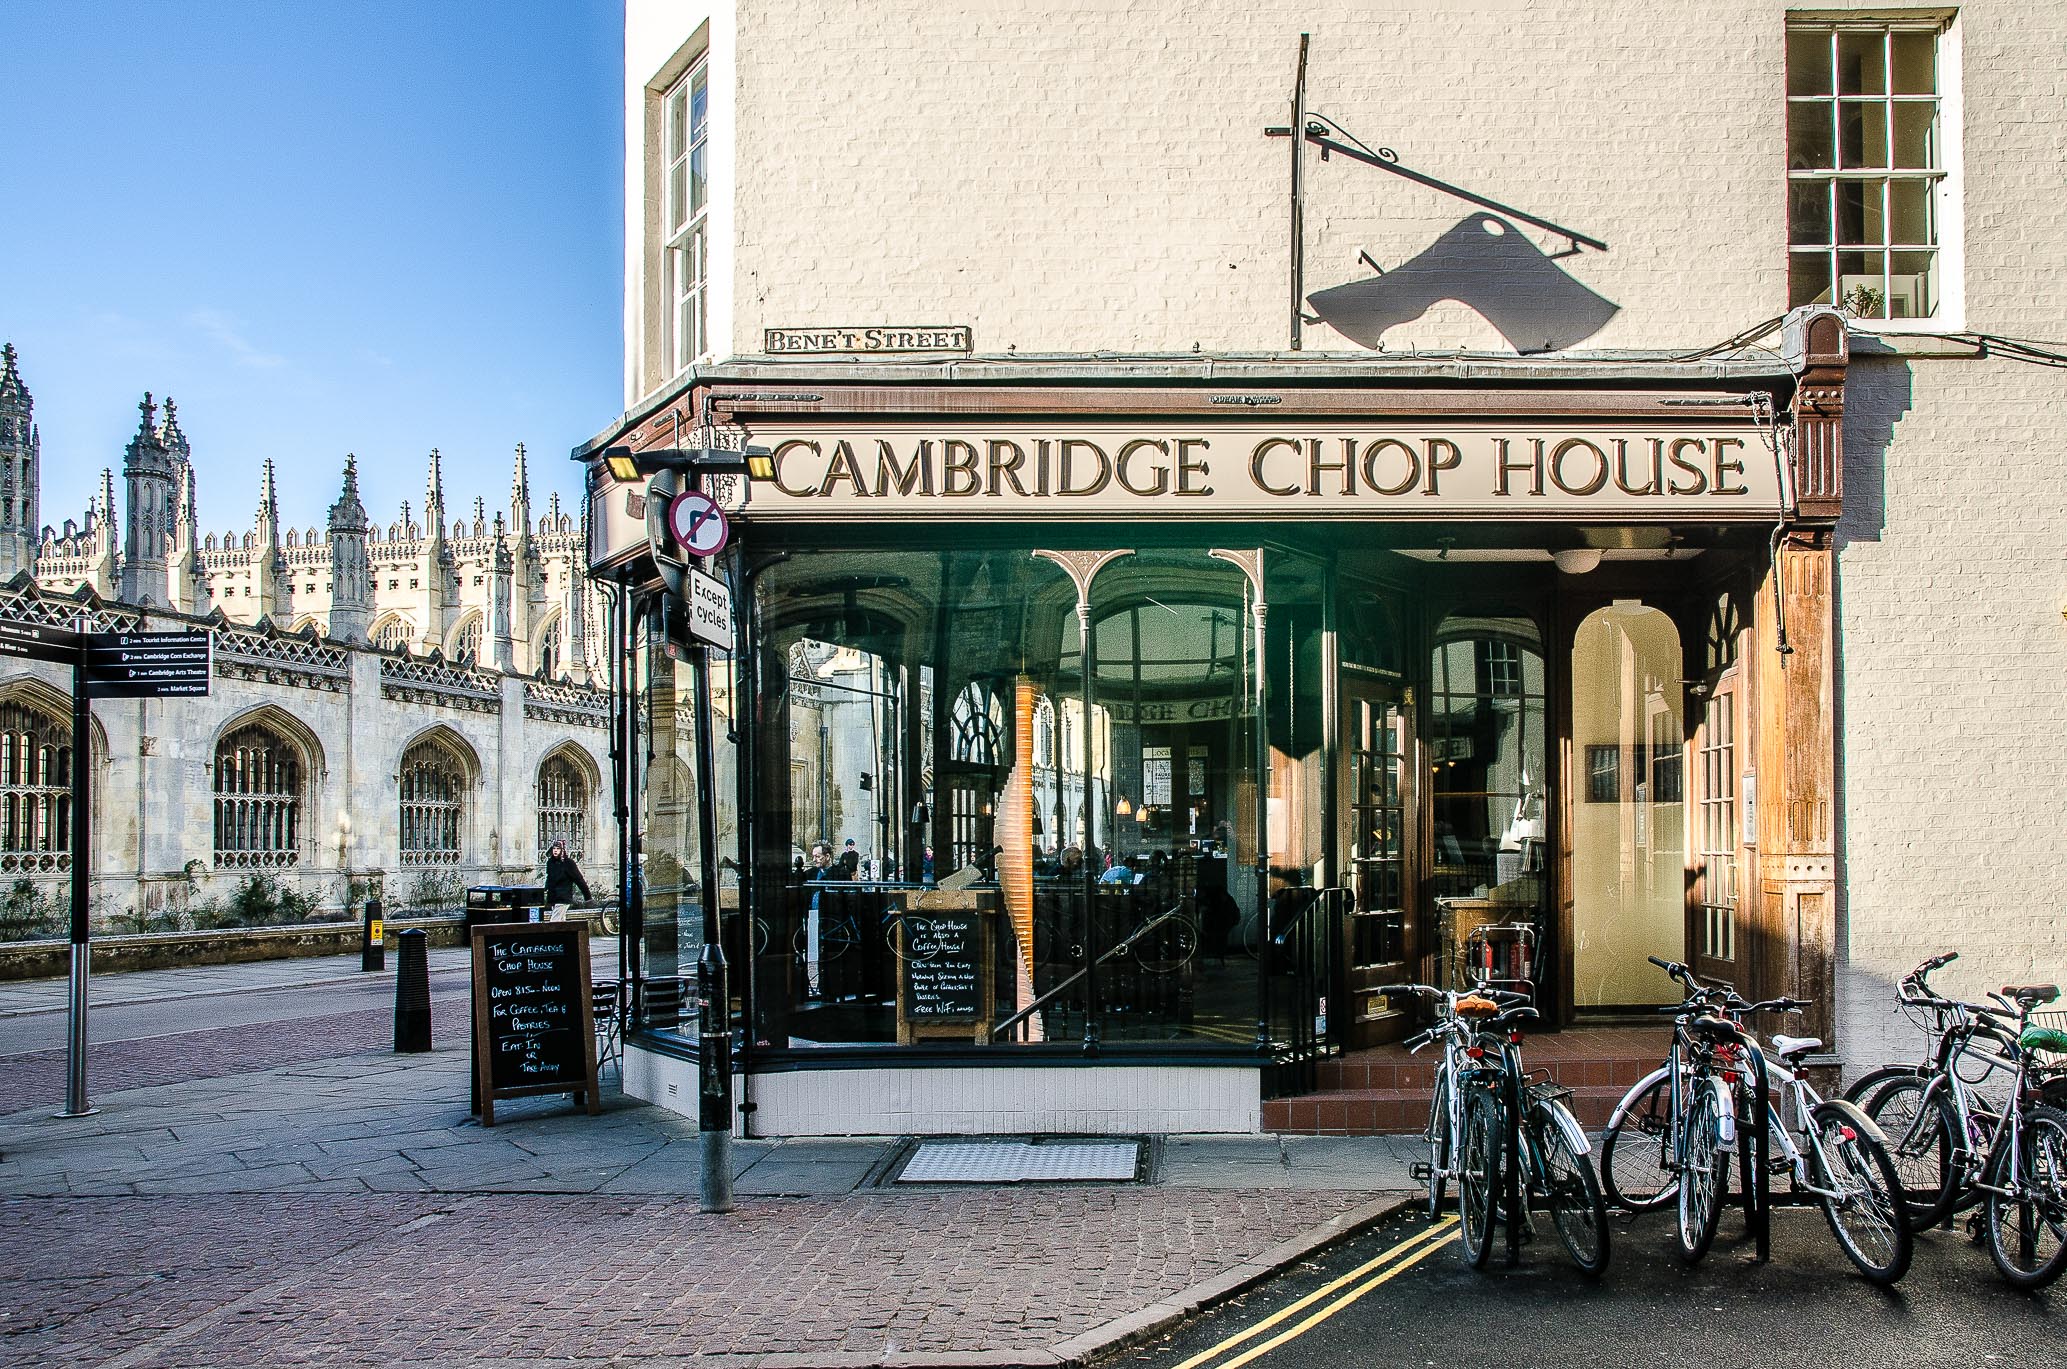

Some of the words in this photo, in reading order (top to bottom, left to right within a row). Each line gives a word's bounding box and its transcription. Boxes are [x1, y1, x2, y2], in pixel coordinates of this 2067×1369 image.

[768, 330, 856, 351] BENE'T
[864, 329, 965, 349] STREET
[773, 438, 1214, 498] CAMBRIDGE
[1248, 437, 1462, 497] CHOP
[1491, 437, 1749, 497] HOUSE
[694, 577, 727, 611] Except
[696, 604, 727, 631] cycles
[143, 653, 169, 661] Cambridge
[182, 652, 207, 660] Exchange
[148, 669, 175, 677] Cambridge
[188, 685, 207, 693] Square
[947, 920, 968, 930] HOUSE
[489, 943, 507, 956] THE
[510, 942, 564, 955] CAMBRIDGE
[498, 960, 522, 971] CHOP
[527, 959, 553, 970] HOUSE
[491, 986, 512, 998] OPEN
[542, 983, 561, 992] NOON
[493, 1003, 507, 1018] FOR
[542, 1001, 558, 1013] TEA
[914, 1004, 933, 1013] FREE
[512, 1017, 551, 1030] PASTRIES
